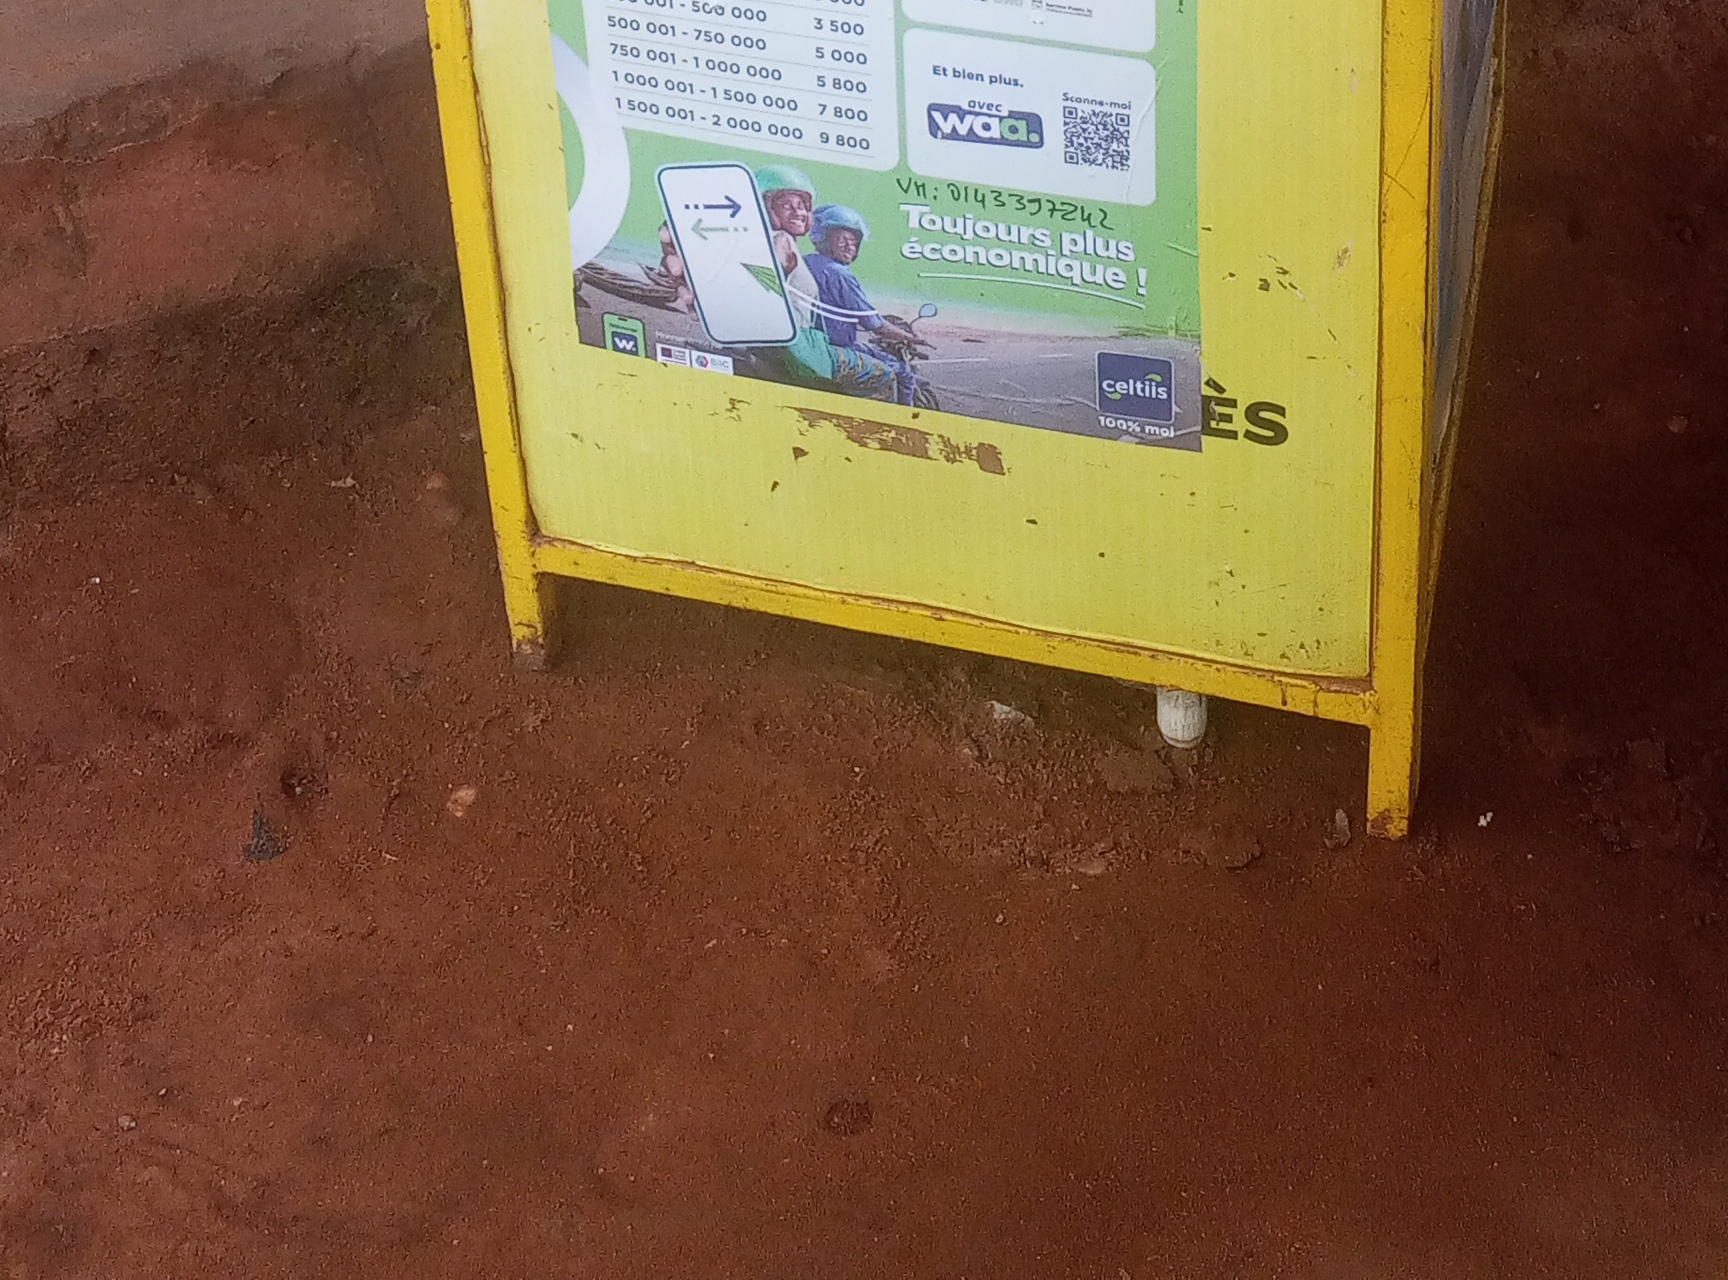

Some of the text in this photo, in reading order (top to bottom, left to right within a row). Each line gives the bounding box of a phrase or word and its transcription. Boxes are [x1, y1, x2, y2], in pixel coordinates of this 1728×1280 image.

[692, 1, 725, 16] 500
[731, 7, 767, 22] 000
[608, 16, 766, 50] 500 001 750 000
[814, 18, 864, 35] 3 500
[610, 43, 782, 81] 750 001 1 000 000
[816, 47, 867, 65] 5 000
[817, 75, 867, 93] 5 800
[932, 65, 1024, 88] Et bien plus.
[612, 71, 798, 111] 1 000 001 1 500 000
[1062, 92, 1132, 111] Scanne-moi
[818, 104, 868, 121] 7 800
[968, 99, 1003, 113] avec
[615, 97, 803, 139] 1 500 001 2 000 000
[820, 132, 870, 150] 9 800
[899, 204, 1135, 262] Toujours plus
[900, 238, 1148, 296] économique !
[1102, 377, 1168, 400] celtiis
[1098, 416, 1176, 438] 100% moi
